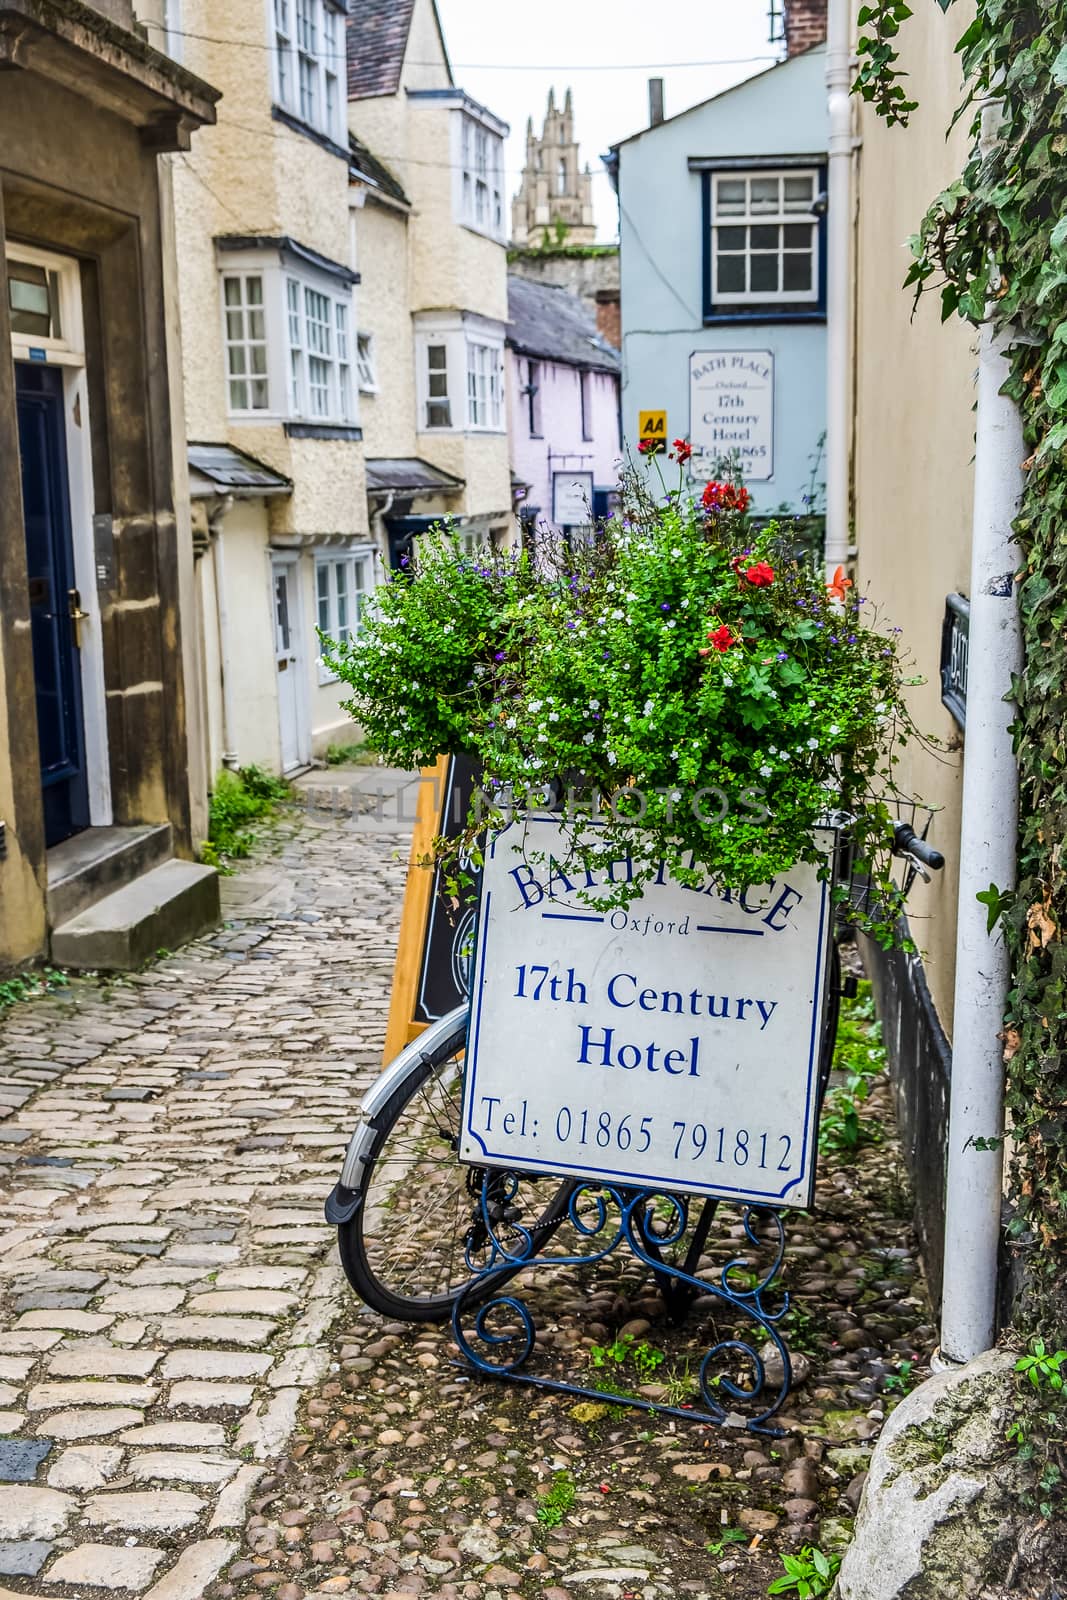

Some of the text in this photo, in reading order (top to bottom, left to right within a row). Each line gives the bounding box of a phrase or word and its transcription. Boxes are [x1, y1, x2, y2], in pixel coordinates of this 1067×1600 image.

[692, 357, 726, 380] BATH
[719, 394, 745, 409] 17th
[643, 417, 665, 433] AA
[702, 412, 760, 426] Century
[713, 428, 750, 440] Hotel
[610, 910, 690, 936] Oxford
[513, 964, 778, 1031] 17th Century
[576, 1024, 701, 1077] Hotel
[481, 1097, 793, 1172] Tel: 01865 791812
